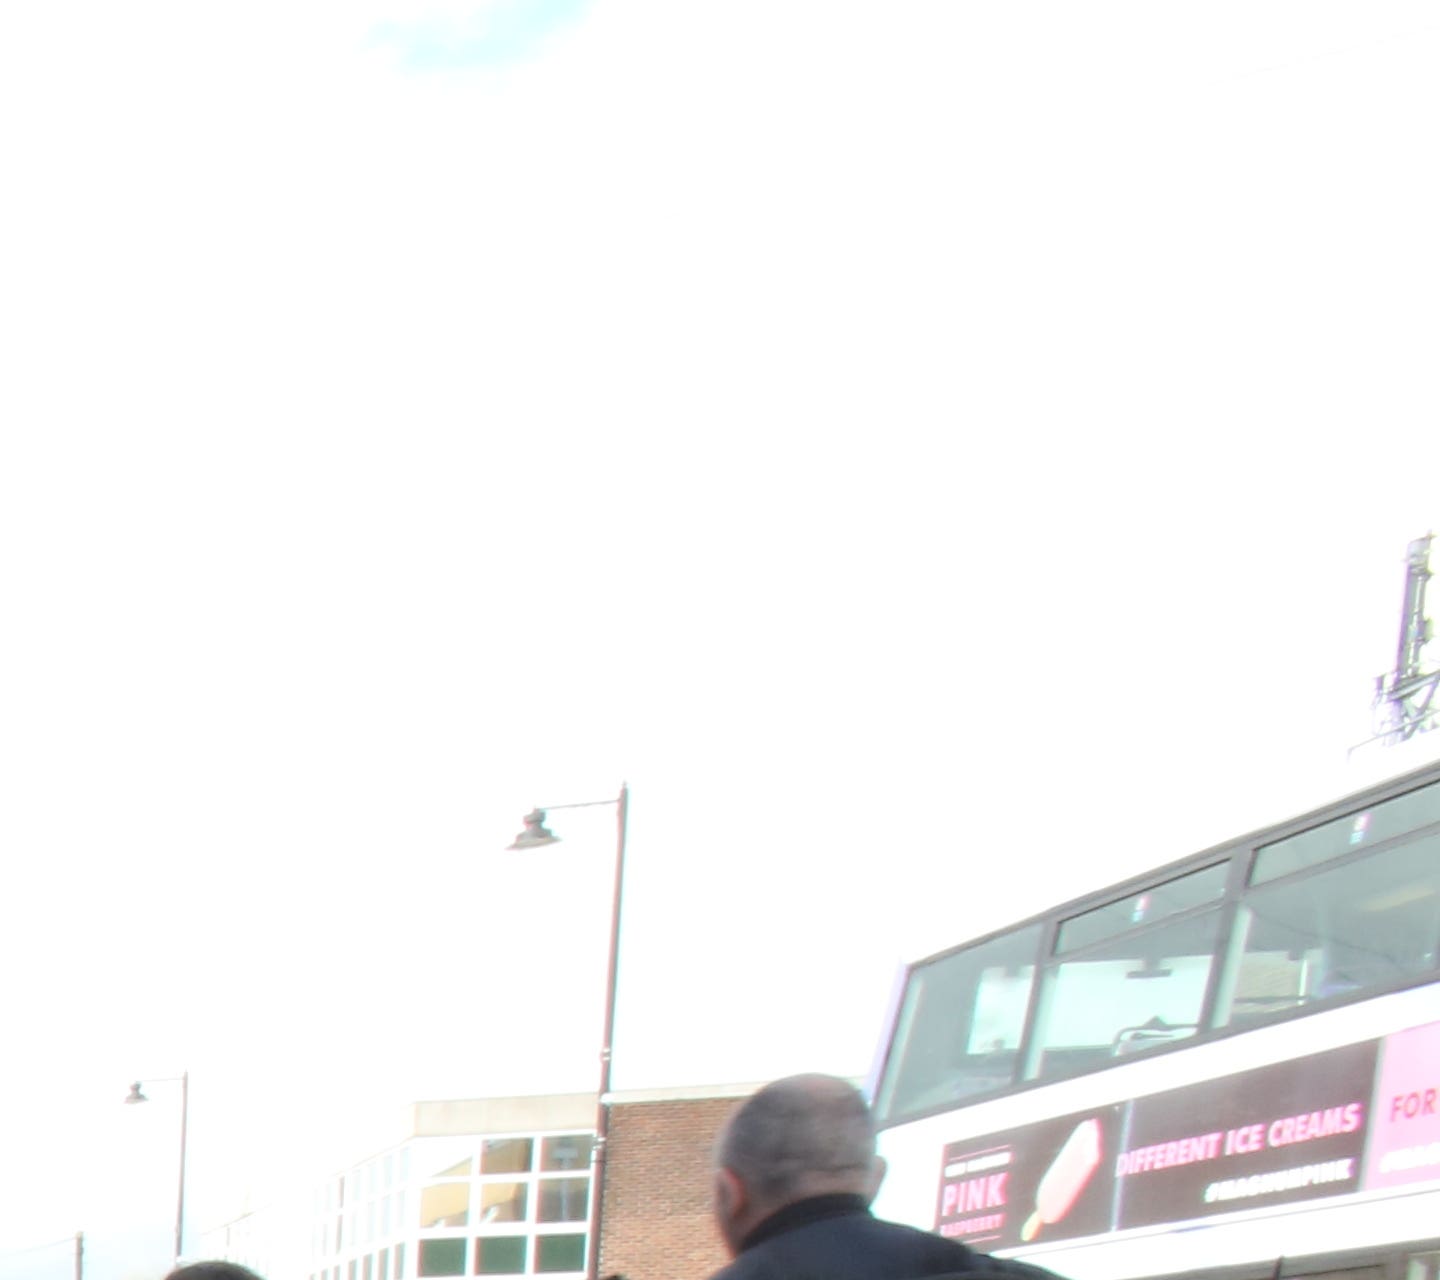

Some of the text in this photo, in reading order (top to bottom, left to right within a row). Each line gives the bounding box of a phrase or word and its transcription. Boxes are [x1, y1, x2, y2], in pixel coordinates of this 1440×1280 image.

[1389, 1088, 1437, 1122] FOR
[1116, 1103, 1363, 1177] DIFFERENT ICE CREAMS
[942, 1172, 1009, 1216] PINK
